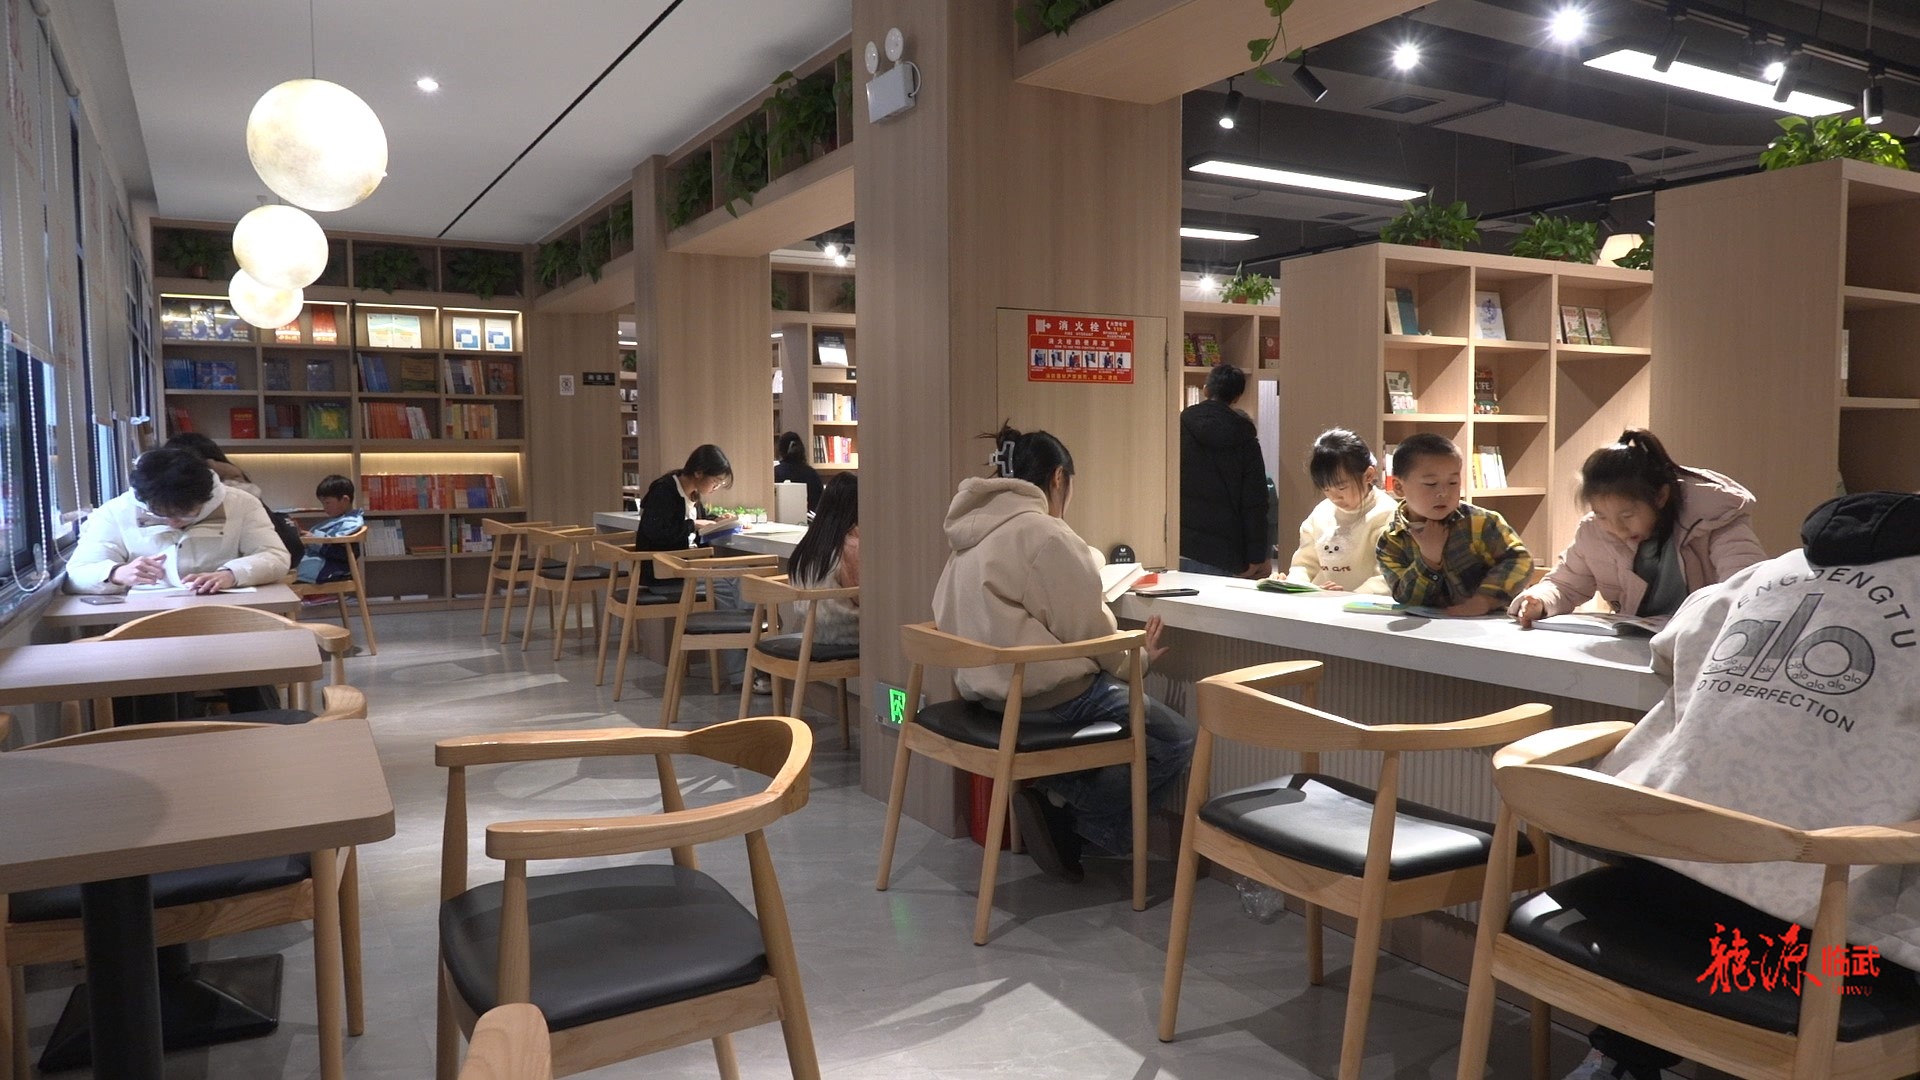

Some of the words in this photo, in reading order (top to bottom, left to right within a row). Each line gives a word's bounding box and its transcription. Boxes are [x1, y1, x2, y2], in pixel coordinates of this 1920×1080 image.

[1058, 319, 1100, 332] 消火栓
[1758, 664, 1775, 673] alo
[1792, 670, 1809, 680] alo
[1843, 673, 1862, 684] alo
[1806, 679, 1825, 690] alo
[1827, 679, 1846, 691] alo
[1708, 680, 1731, 692] TO
[1732, 683, 1856, 733] PERFECTION
